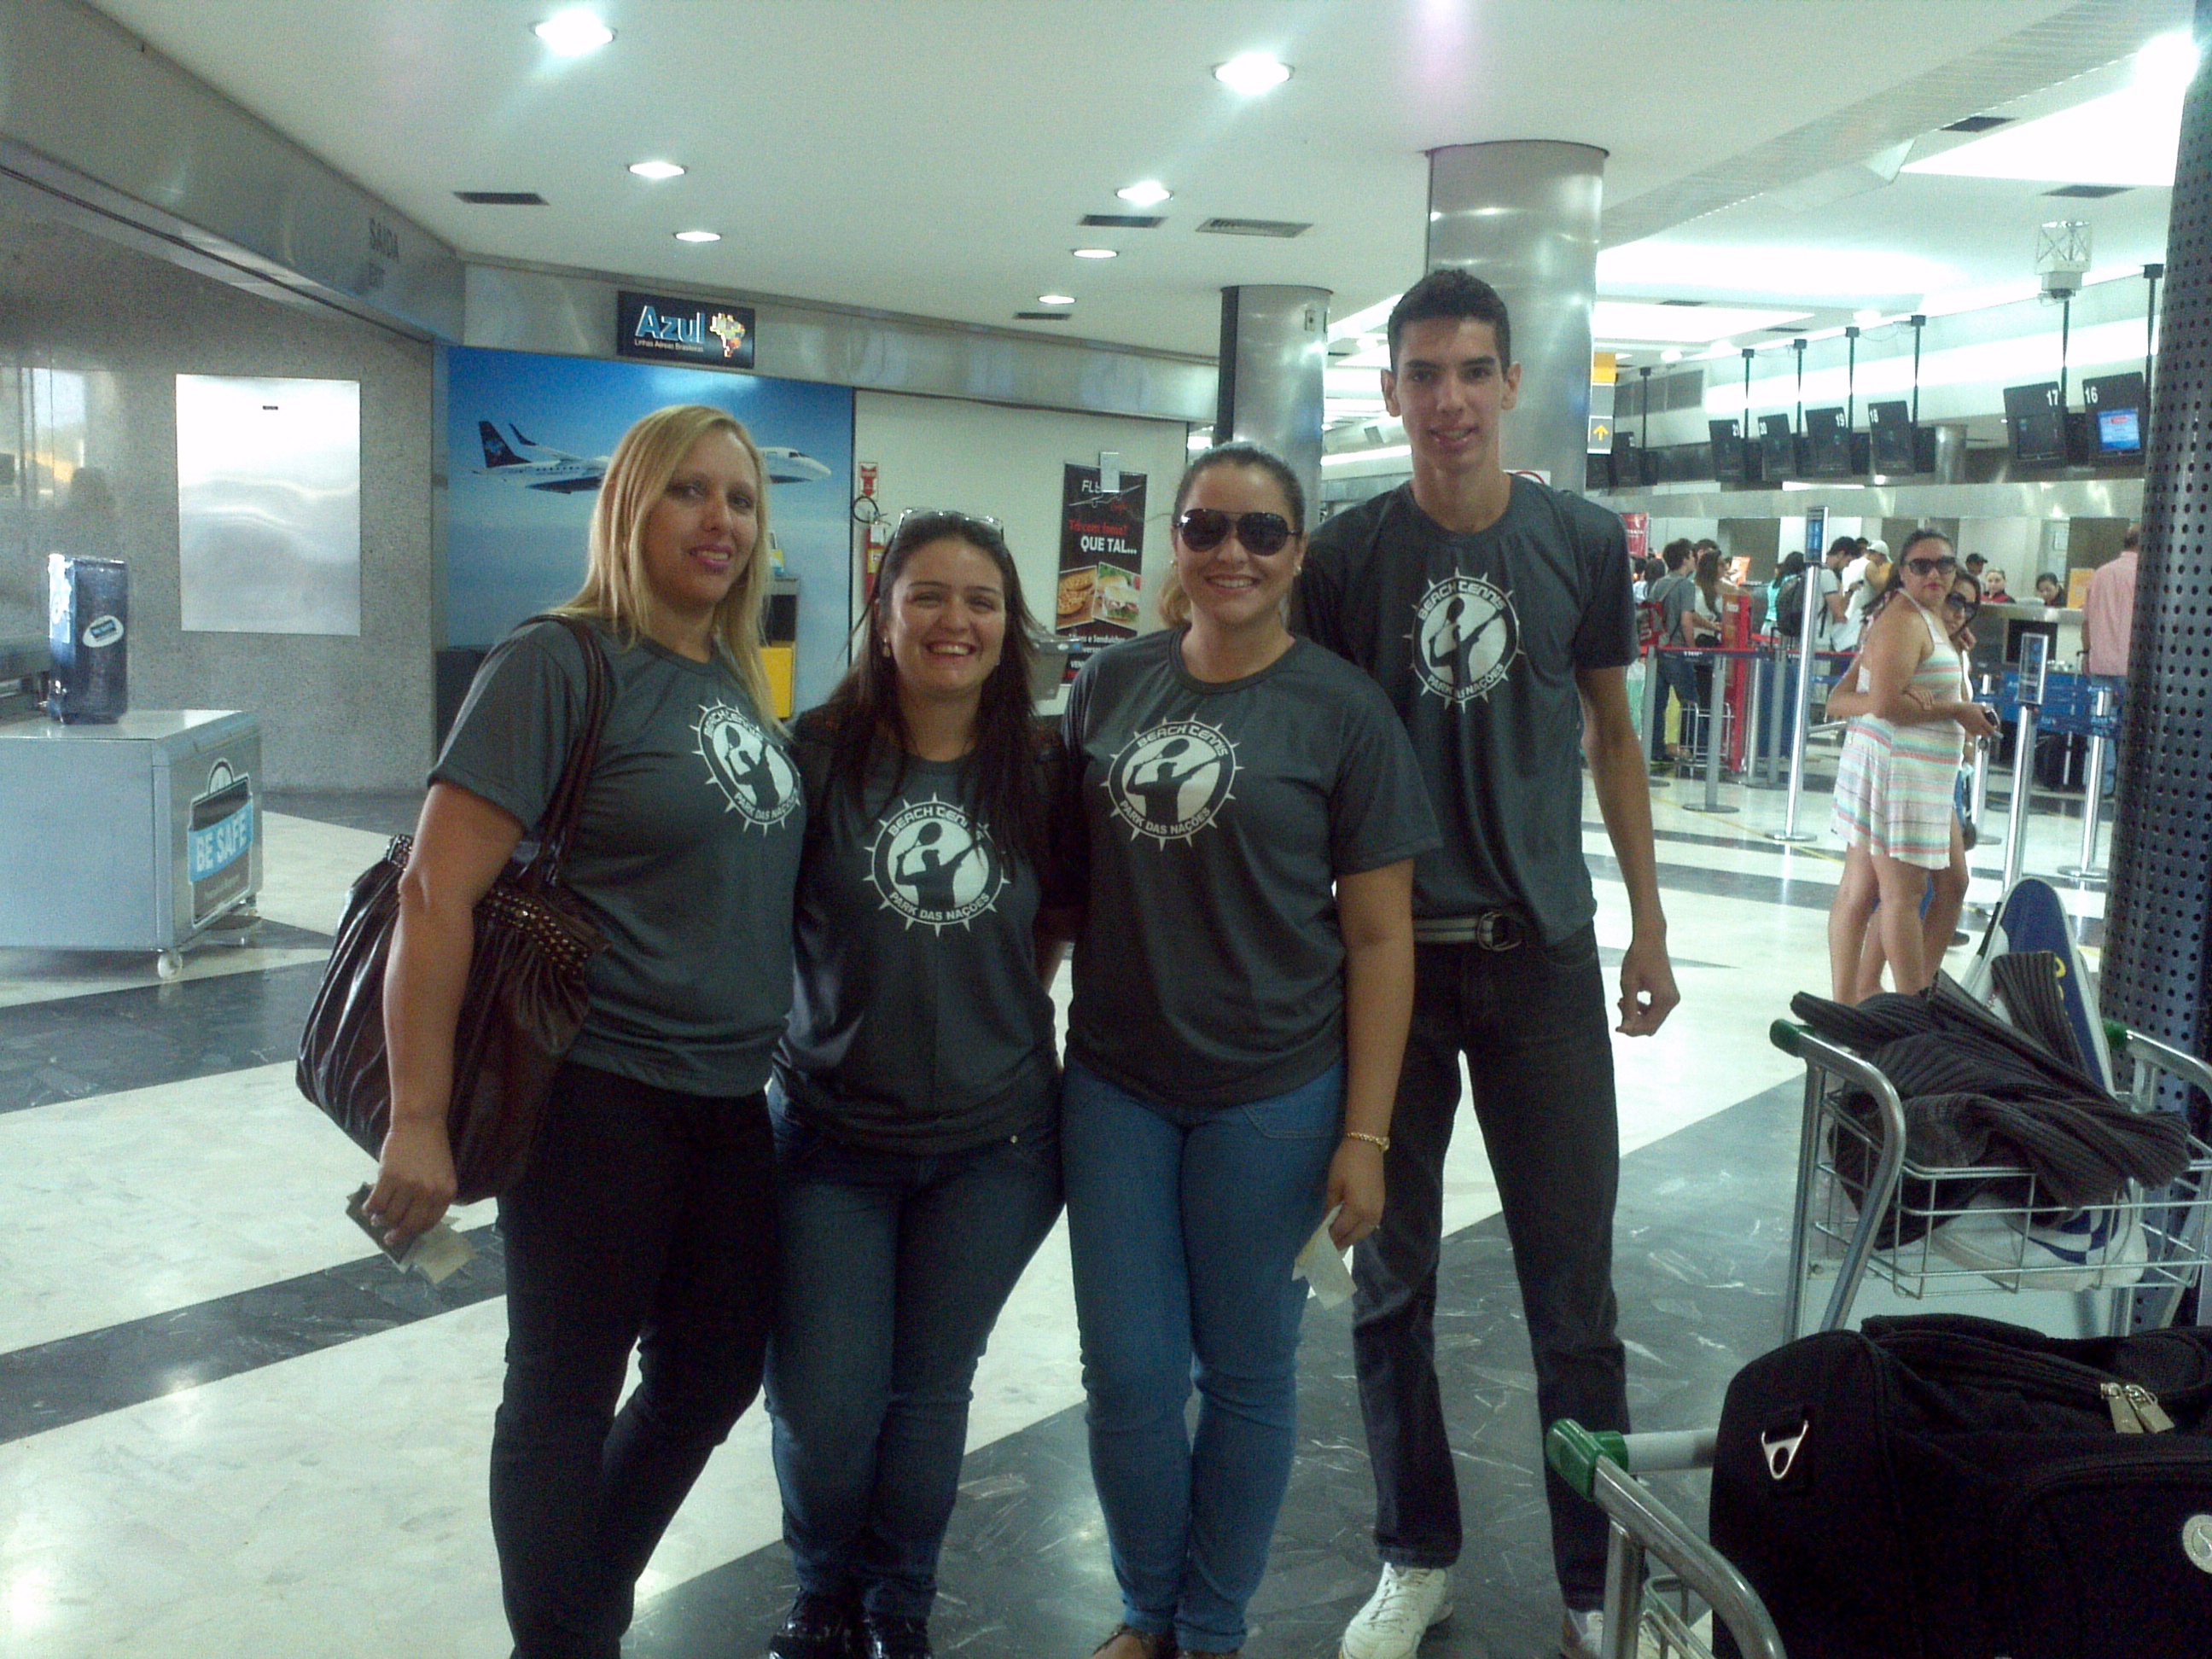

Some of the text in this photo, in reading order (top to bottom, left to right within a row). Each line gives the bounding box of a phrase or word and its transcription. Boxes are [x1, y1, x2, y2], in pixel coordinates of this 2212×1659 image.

[635, 305, 705, 344] Azul
[2046, 388, 2058, 406] 17
[2085, 386, 2098, 404] 16
[1836, 412, 1846, 428] 19
[1080, 535, 1138, 555] QUE TAL...
[1417, 581, 1457, 620] BEACH
[1136, 725, 1186, 748] BEACH
[888, 806, 934, 837] BEACH
[1120, 800, 1147, 827] PARK
[1145, 821, 1168, 835] DAS
[196, 812, 247, 872] BE SAFE
[888, 891, 918, 916] PARK
[919, 909, 943, 922] DAS
